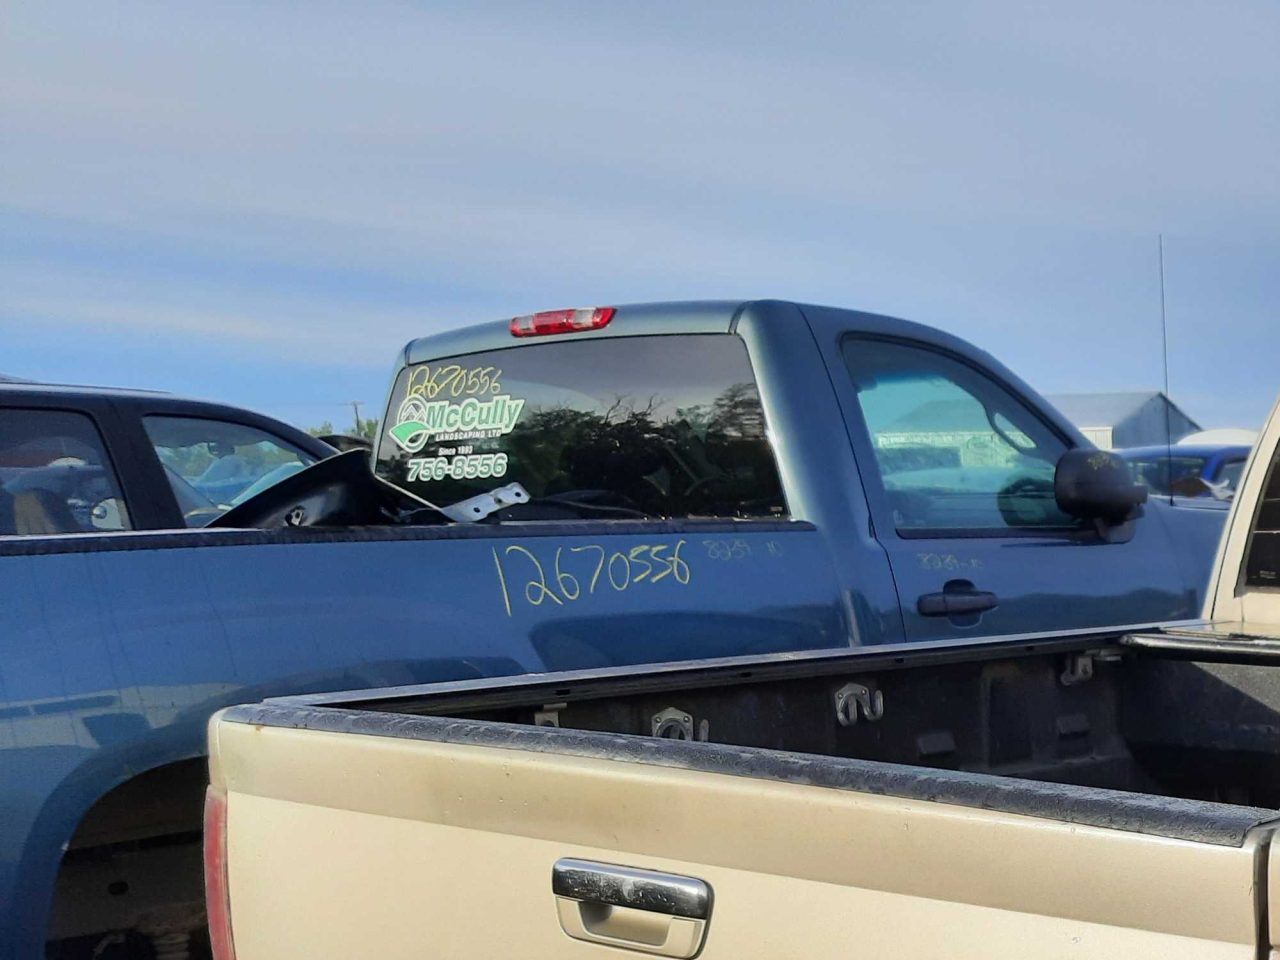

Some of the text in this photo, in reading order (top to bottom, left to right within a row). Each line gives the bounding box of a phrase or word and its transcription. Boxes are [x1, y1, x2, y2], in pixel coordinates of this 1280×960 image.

[406, 365, 503, 398] 12670556
[426, 396, 525, 433] McCully
[435, 431, 486, 442] LANDSCAPING
[438, 447, 457, 456] Since
[407, 453, 508, 482] 756-8556
[493, 540, 690, 616] 12670556
